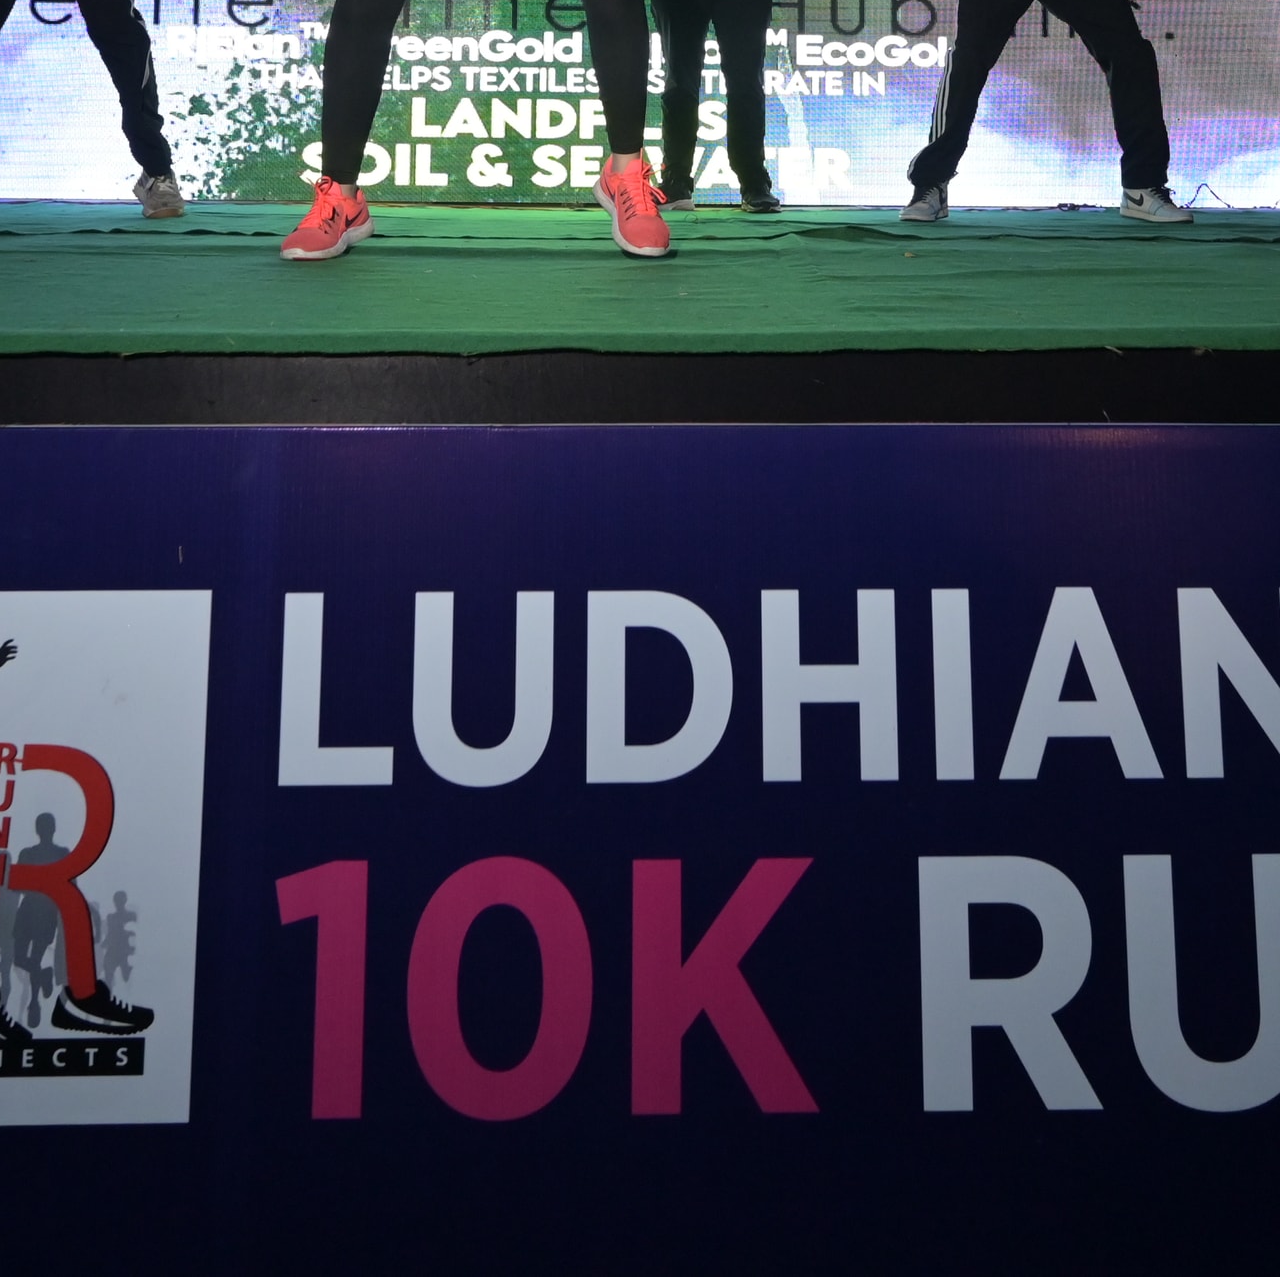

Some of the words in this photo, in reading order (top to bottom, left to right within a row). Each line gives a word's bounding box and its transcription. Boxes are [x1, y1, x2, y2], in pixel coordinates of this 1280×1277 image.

[852, 71, 886, 96] IN
[466, 146, 513, 188] &
[274, 855, 820, 1121] 10K
